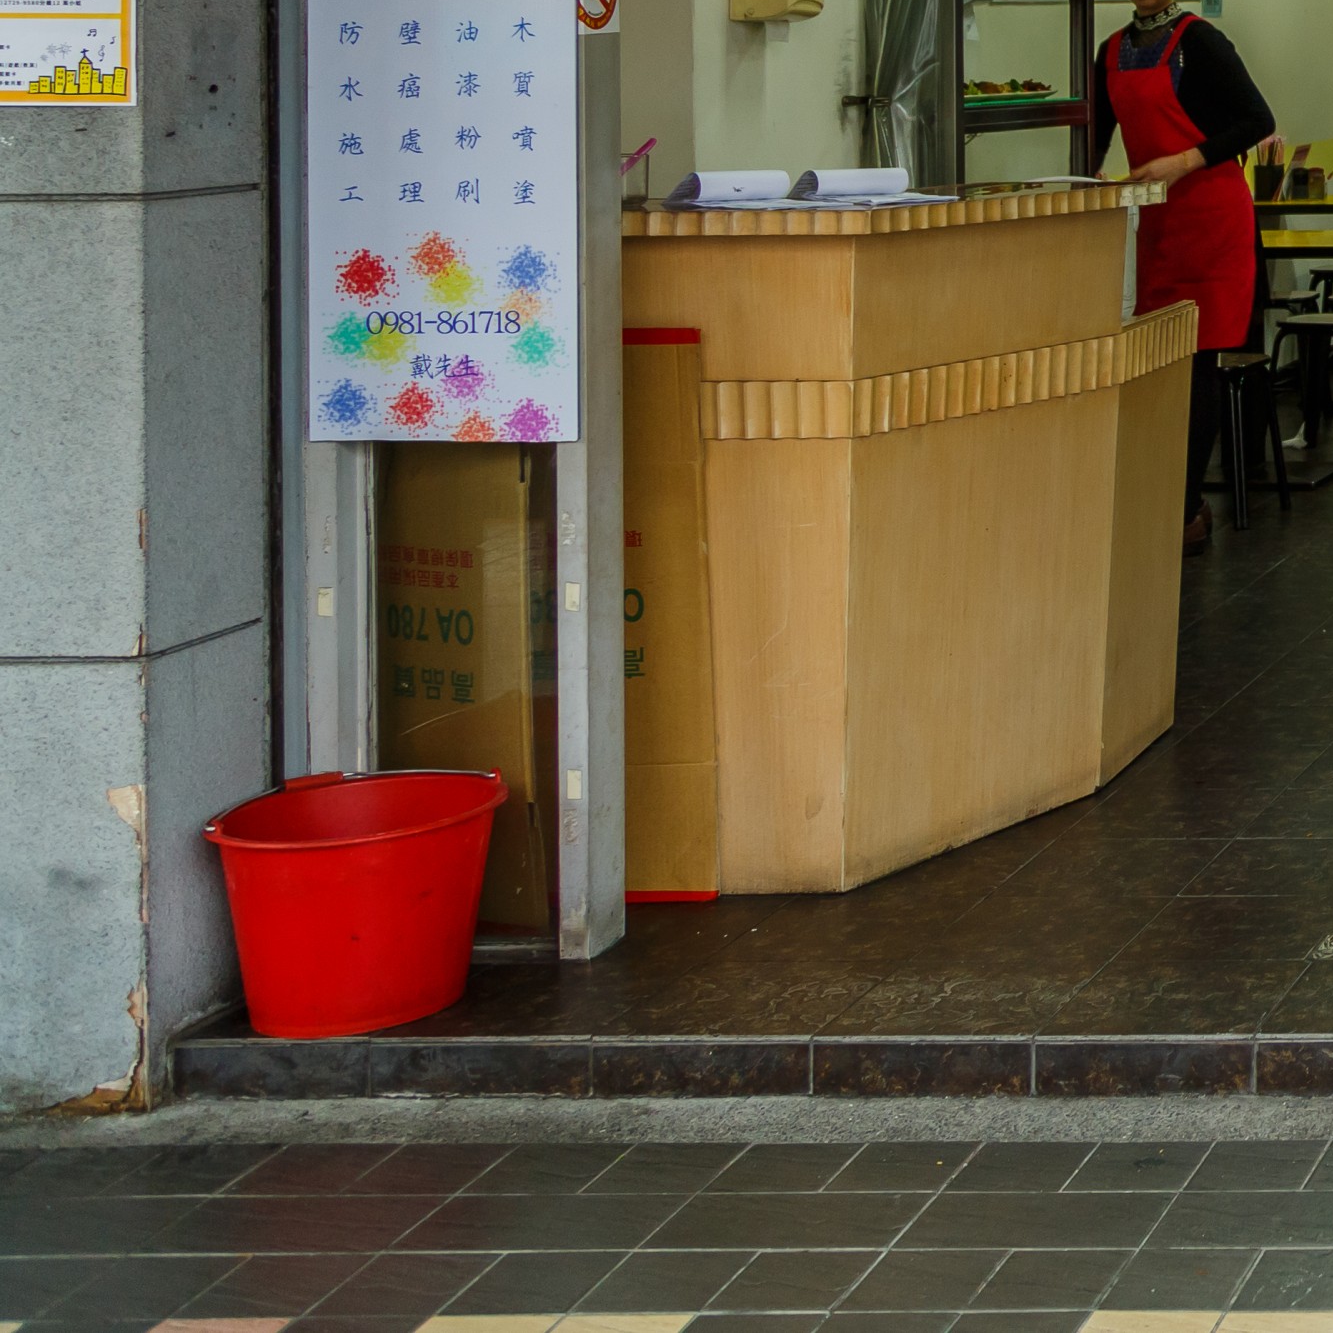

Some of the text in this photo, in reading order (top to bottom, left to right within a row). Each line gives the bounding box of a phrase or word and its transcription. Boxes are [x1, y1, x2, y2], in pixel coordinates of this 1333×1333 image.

[338, 20, 364, 204] 防水施工
[398, 21, 425, 205] 壁癌處理
[456, 20, 482, 205] 油漆粉刷
[511, 17, 537, 206] 木質噴塗
[366, 310, 521, 336] 0981-861718
[410, 355, 479, 382] 戴先生
[387, 604, 474, 646] OA 780
